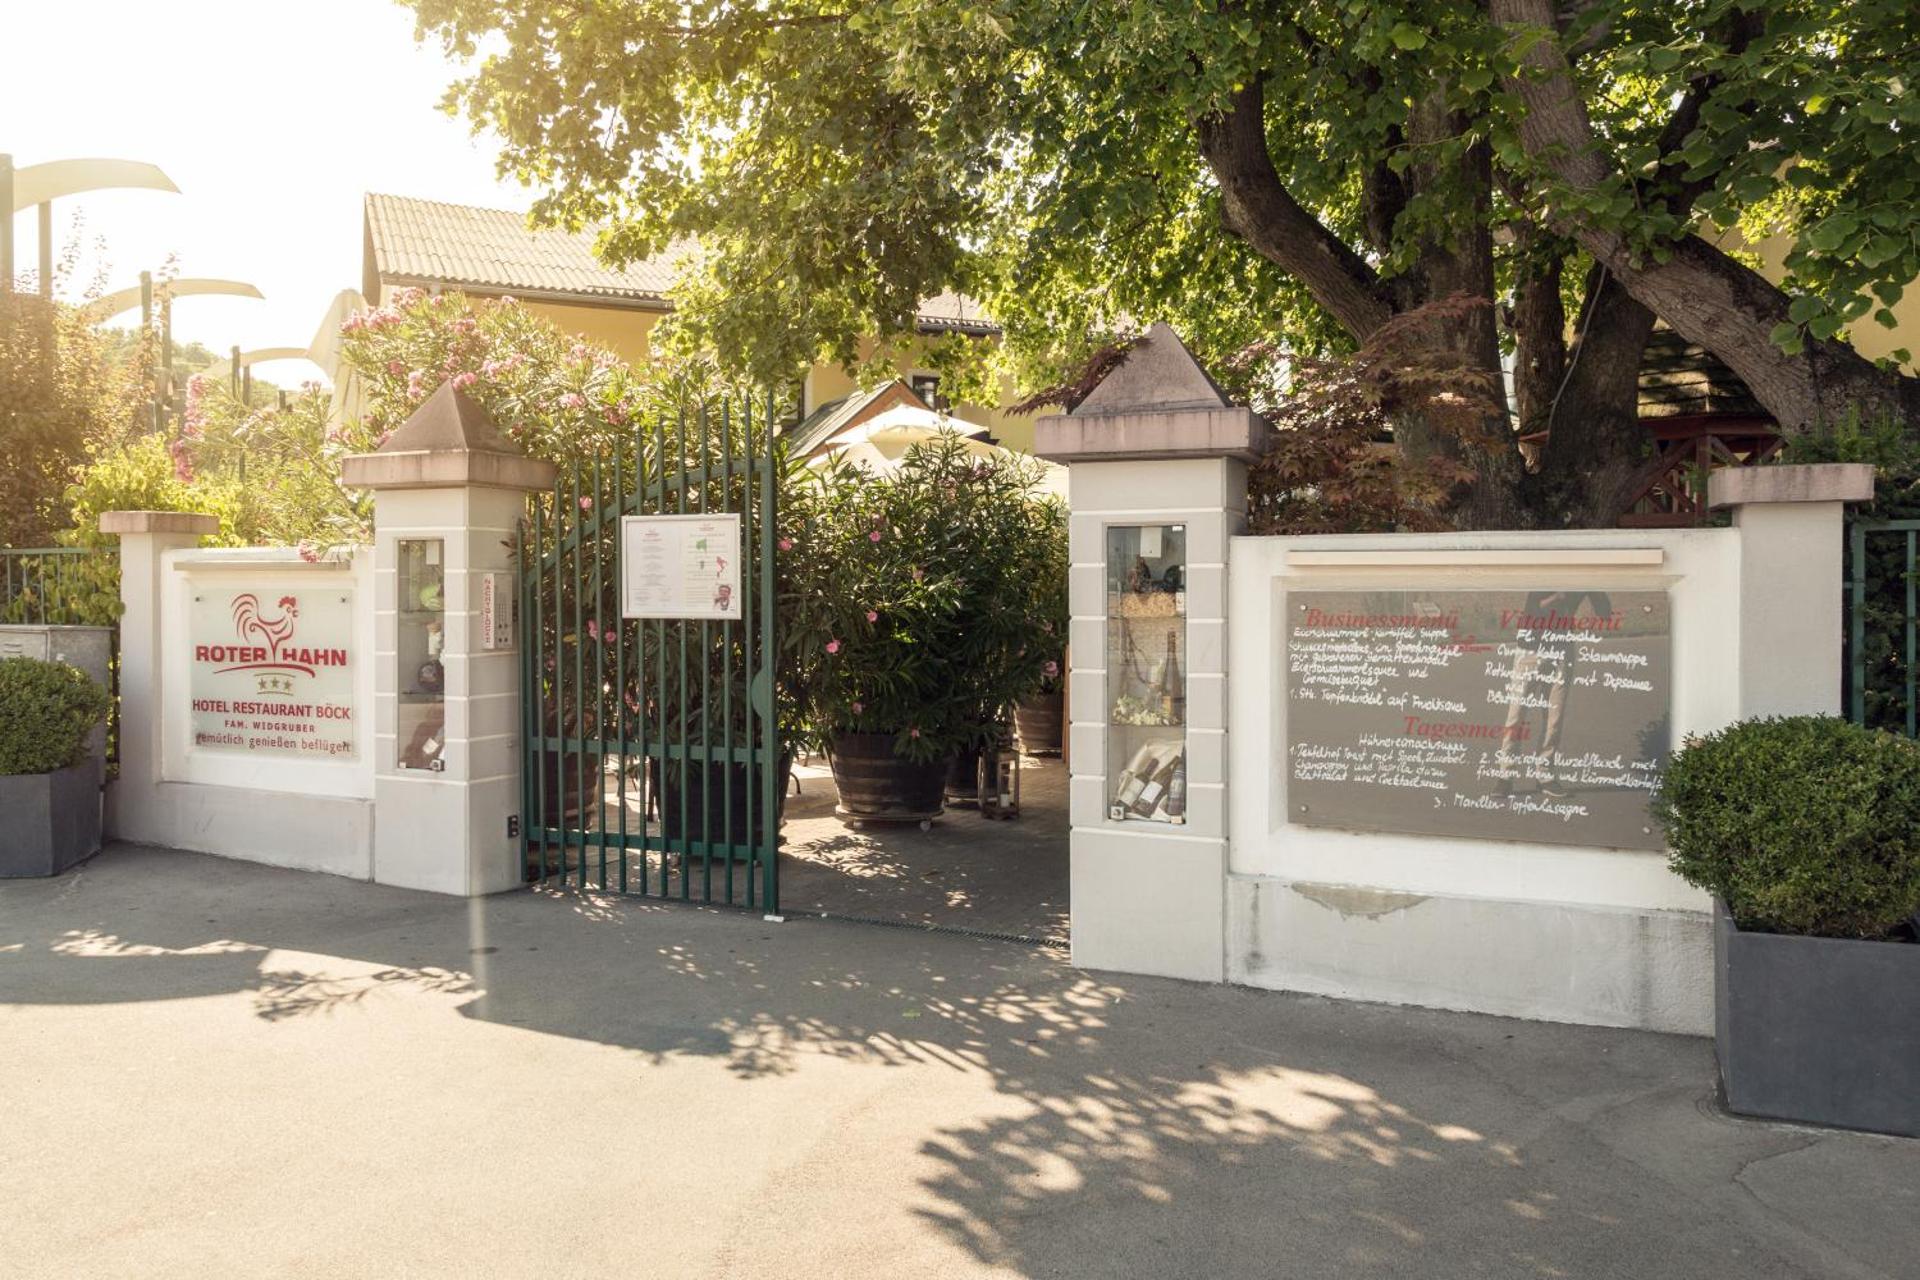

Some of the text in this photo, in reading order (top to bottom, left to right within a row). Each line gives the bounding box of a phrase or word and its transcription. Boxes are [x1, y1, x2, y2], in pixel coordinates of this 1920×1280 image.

[1305, 608, 1459, 629] Businessmenü
[1501, 609, 1625, 630] Vitalmenü
[195, 645, 347, 666] ROTER HAHN
[1408, 667, 1429, 679] und
[1573, 670, 1597, 686] mit
[192, 699, 350, 720] HOTEL RESTAURANT BÖCK
[1387, 692, 1408, 711] auf
[224, 719, 315, 733] FAM. WIDGRUBER
[1403, 716, 1531, 741] Tagesmenü
[195, 732, 244, 746] gemütlich
[249, 736, 296, 749] genießen
[1372, 751, 1393, 762] mit
[1631, 758, 1657, 770] mit
[1353, 773, 1376, 783] und
[1559, 771, 1578, 782] und
[1433, 796, 1446, 808] 3.
